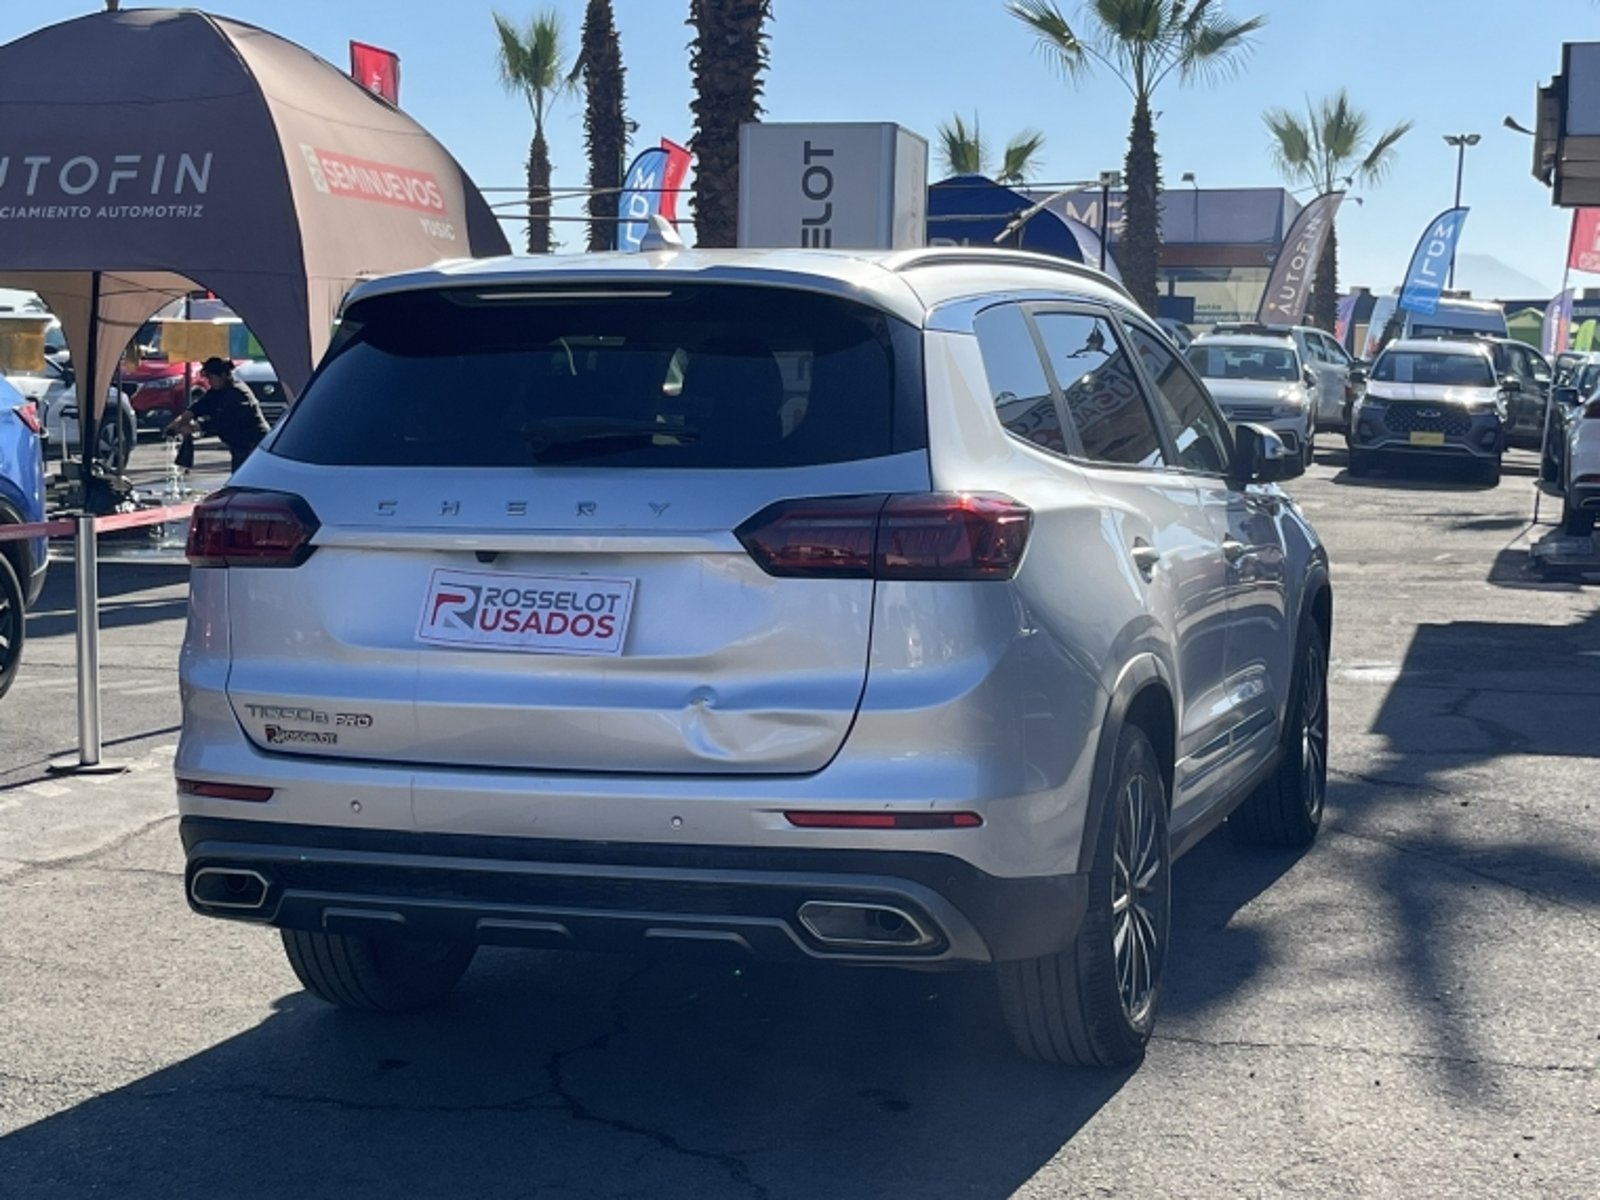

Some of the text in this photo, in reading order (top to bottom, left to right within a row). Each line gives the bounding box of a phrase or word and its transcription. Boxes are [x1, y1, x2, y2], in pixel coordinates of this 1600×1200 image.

[320, 157, 443, 210] SEMINUEVOS
[97, 205, 203, 218] AUTOMOTRIZ
[377, 500, 673, 517] CHERY
[484, 587, 621, 613] ROSSELOT
[479, 608, 615, 639] USADOS
